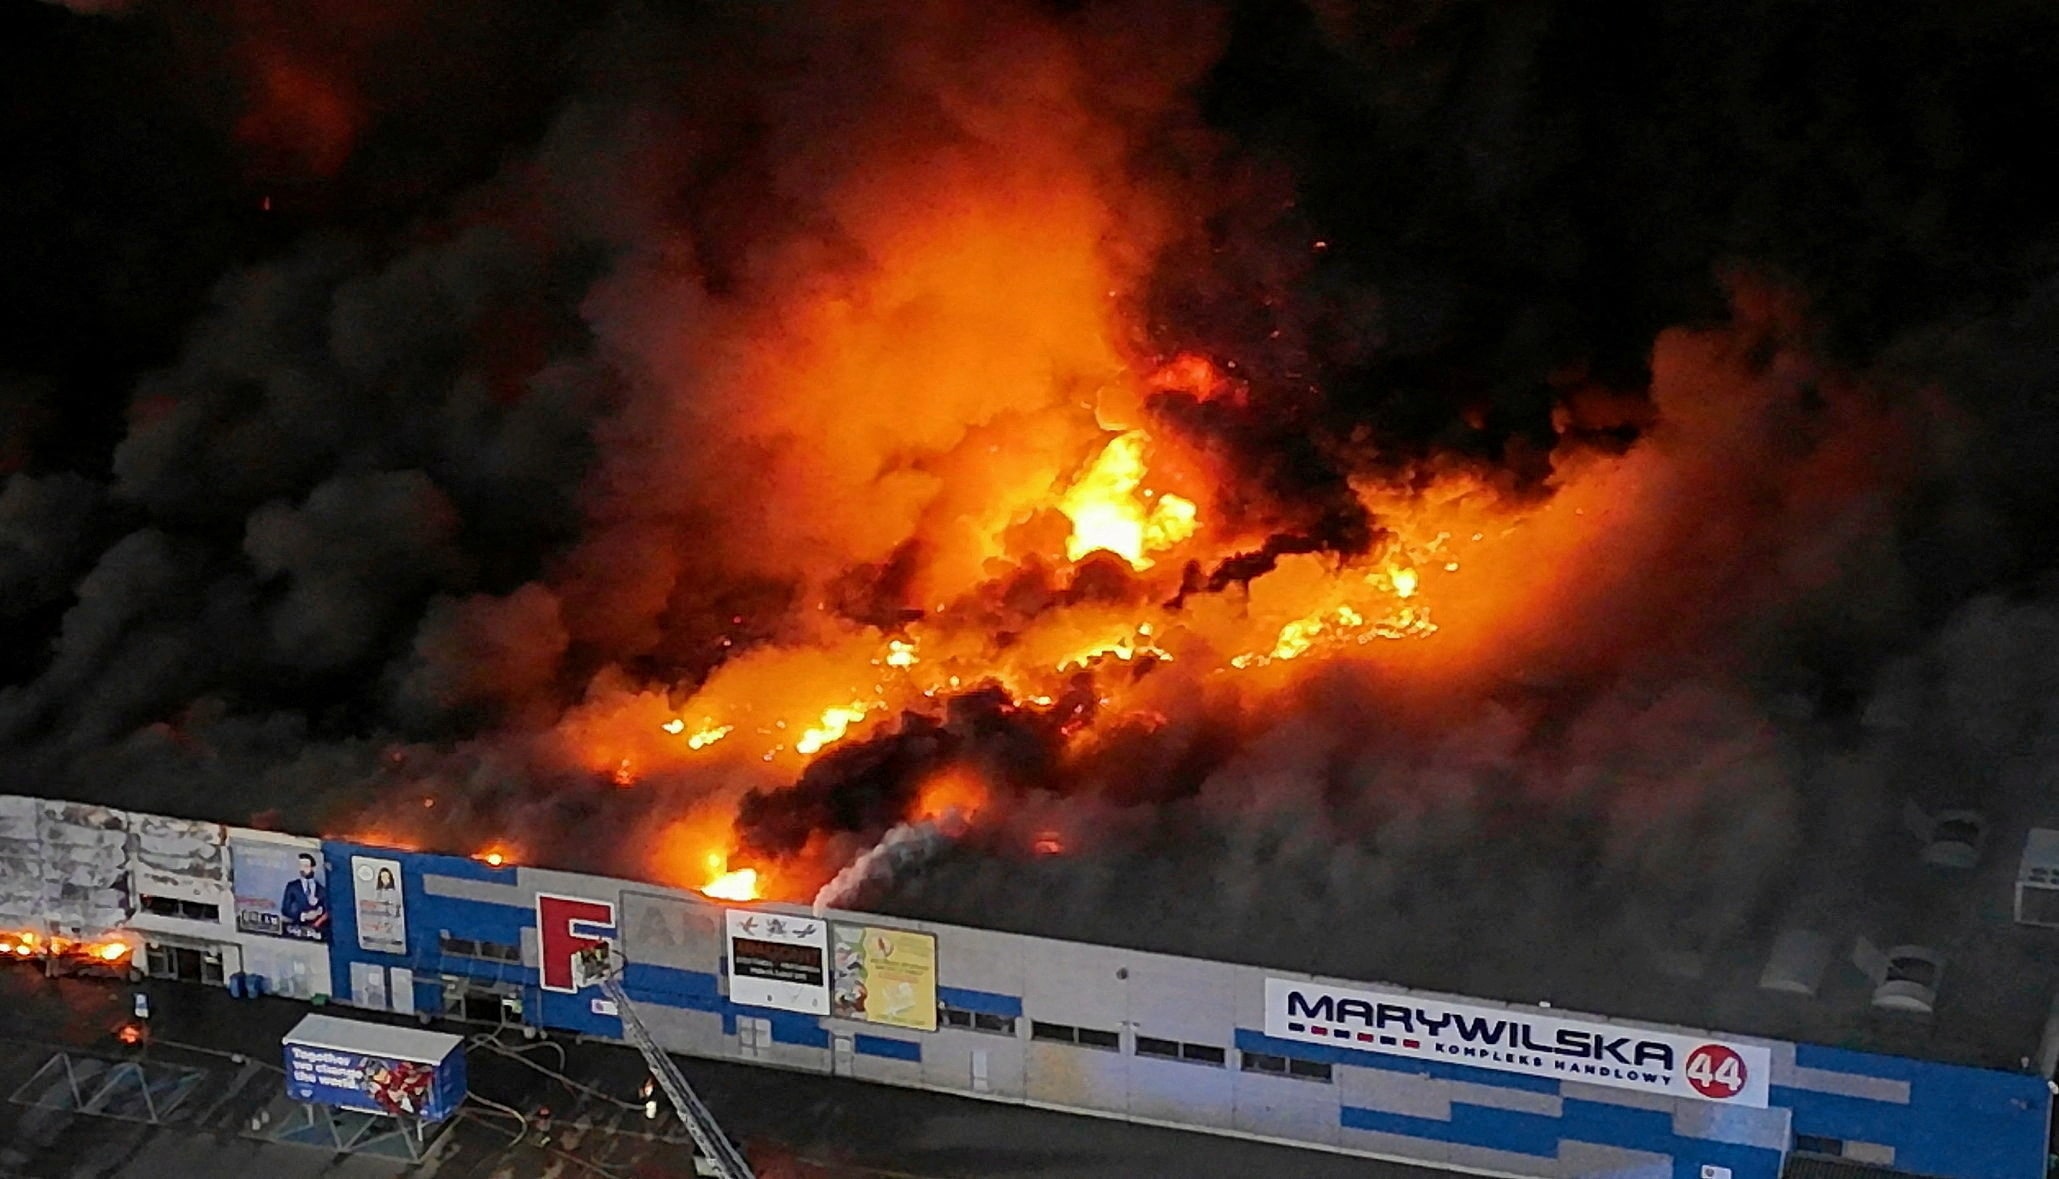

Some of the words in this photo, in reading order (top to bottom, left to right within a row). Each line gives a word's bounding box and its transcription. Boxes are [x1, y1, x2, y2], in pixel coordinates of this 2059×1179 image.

[536, 892, 615, 994] F
[1288, 991, 1674, 1071] MARYWILSKA
[291, 1047, 351, 1066] Together
[293, 1070, 317, 1083] the
[1435, 1043, 1543, 1067] KOMPLEKS
[1555, 1060, 1671, 1086] HANDLOWY
[1687, 1053, 1742, 1091] 44
